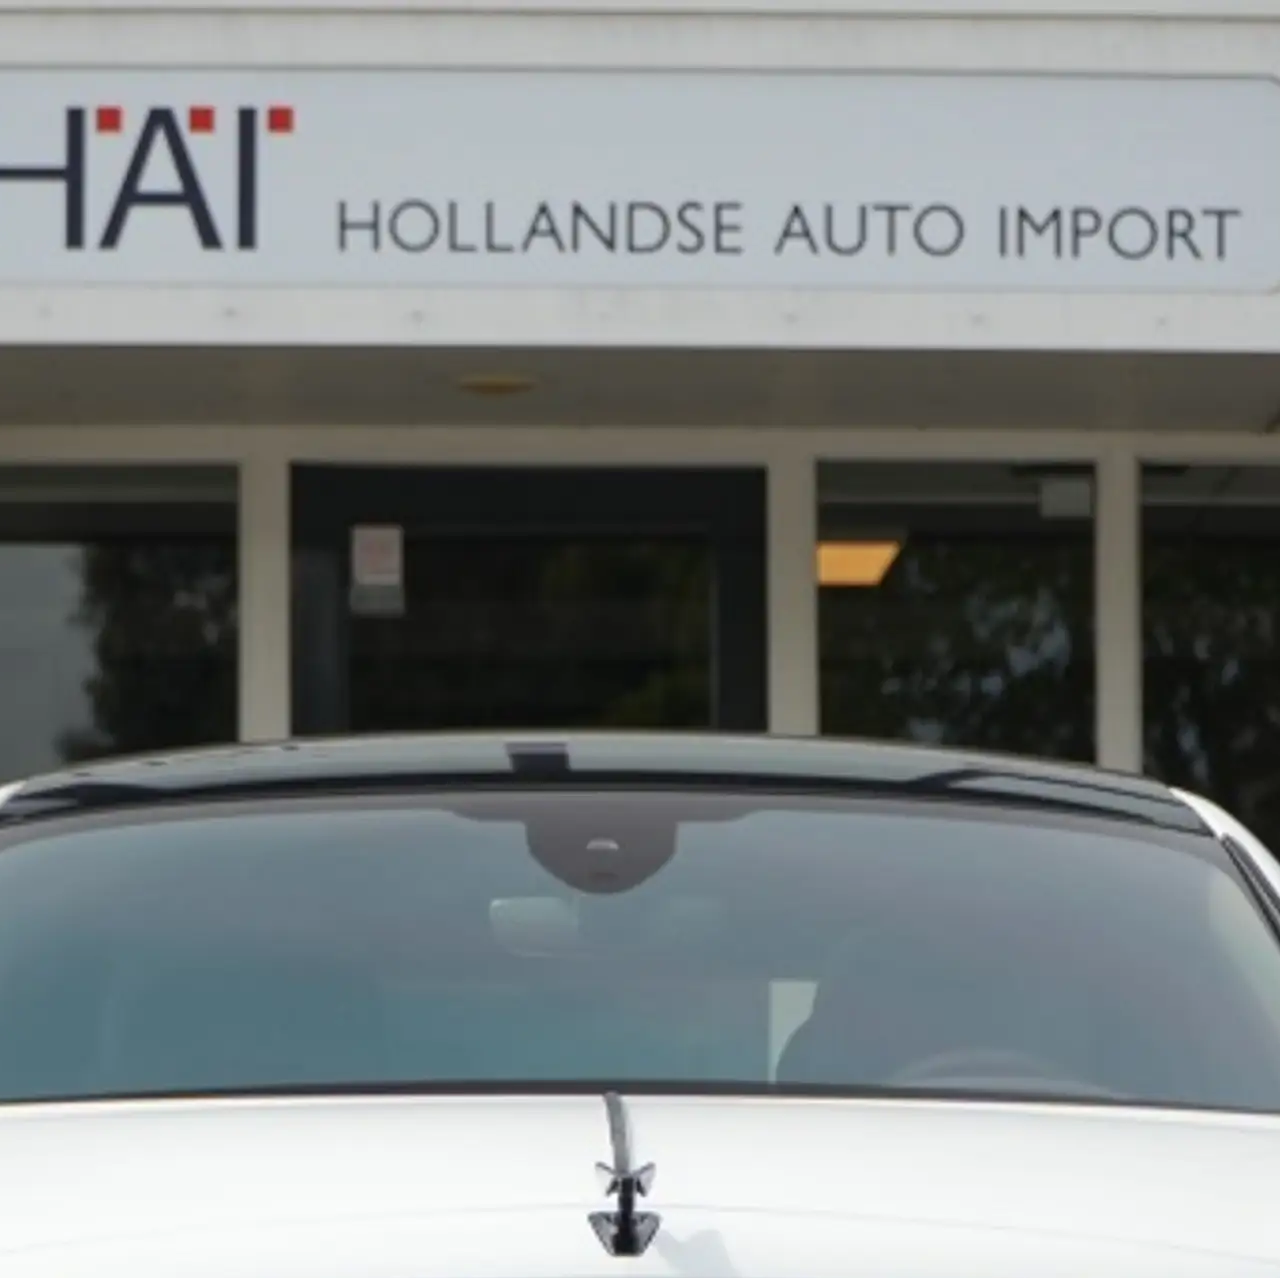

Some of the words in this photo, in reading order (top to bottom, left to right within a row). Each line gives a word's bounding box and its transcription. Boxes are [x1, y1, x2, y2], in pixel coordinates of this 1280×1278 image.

[338, 199, 743, 255] HOLLANDSE
[774, 203, 965, 257] AUTO
[999, 206, 1242, 261] IMPORT
